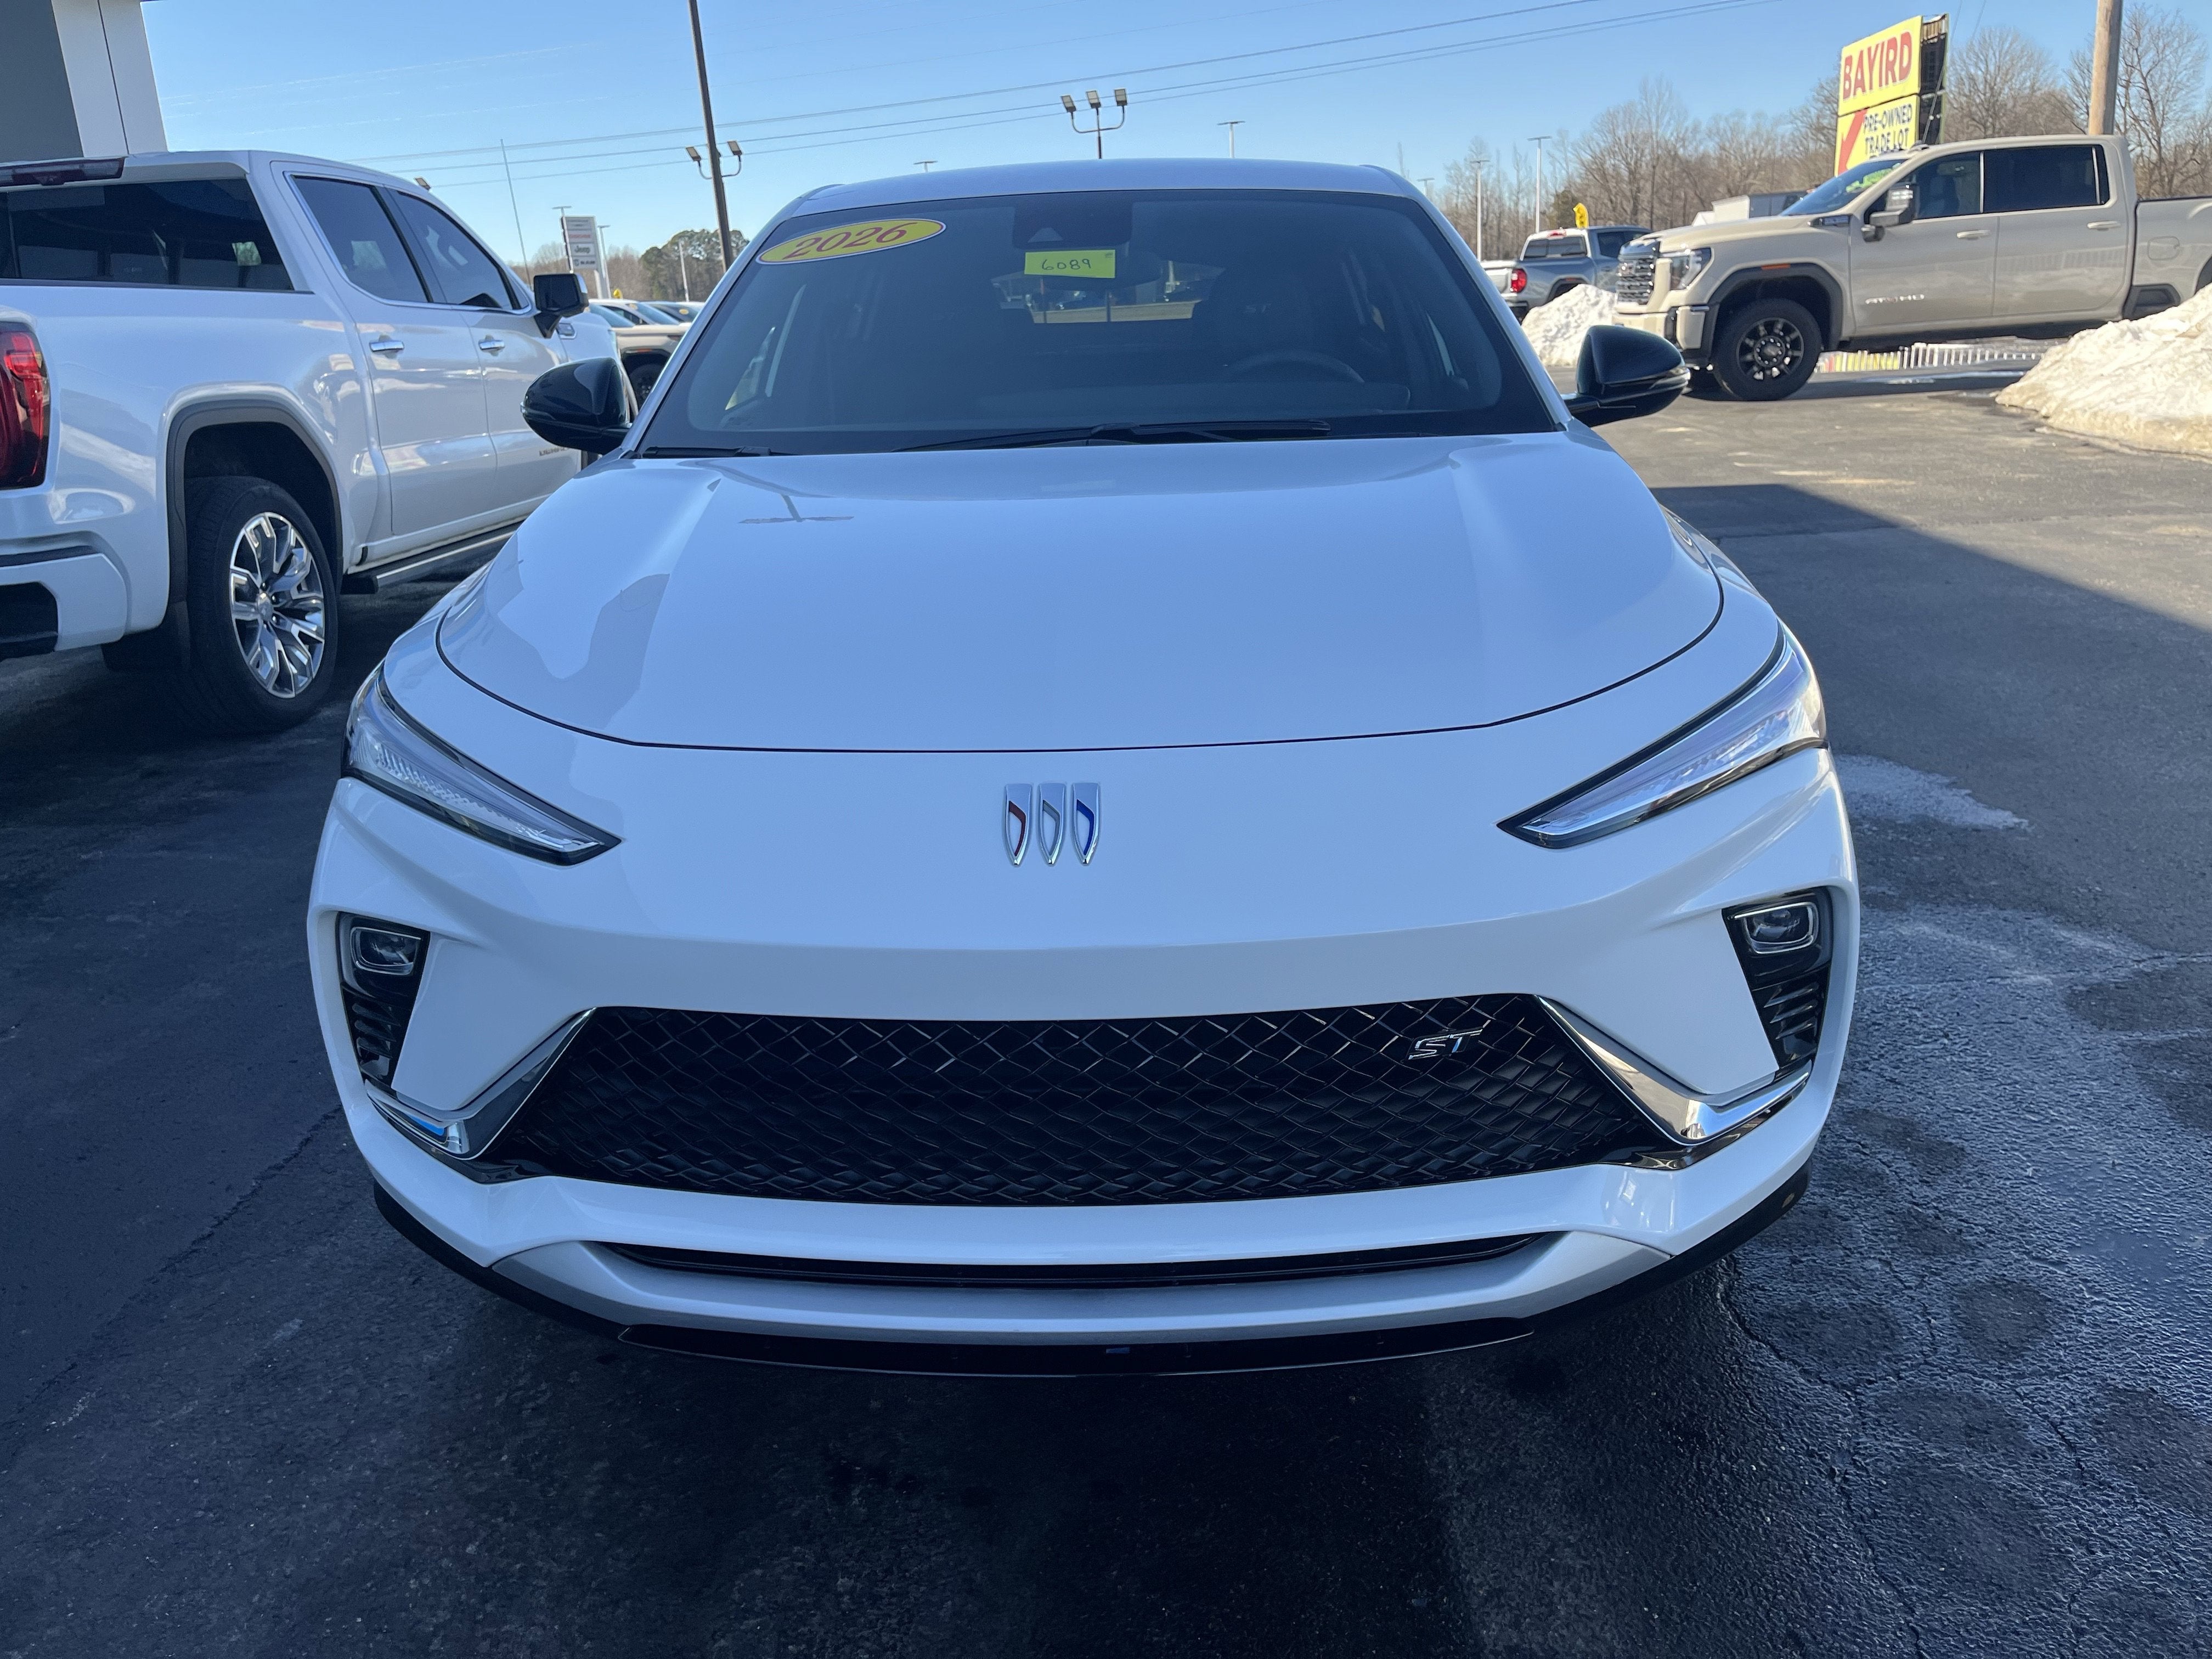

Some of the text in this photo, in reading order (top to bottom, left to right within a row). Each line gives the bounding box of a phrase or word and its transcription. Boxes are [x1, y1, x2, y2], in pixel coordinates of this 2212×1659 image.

[1843, 31, 1912, 101] BAYIRD
[1864, 103, 1913, 133] PRE-OWNED
[1865, 127, 1909, 156] TRADE LOT
[782, 222, 918, 259] 2026
[1042, 258, 1092, 270] 6089
[1408, 1026, 1484, 1060] ST
